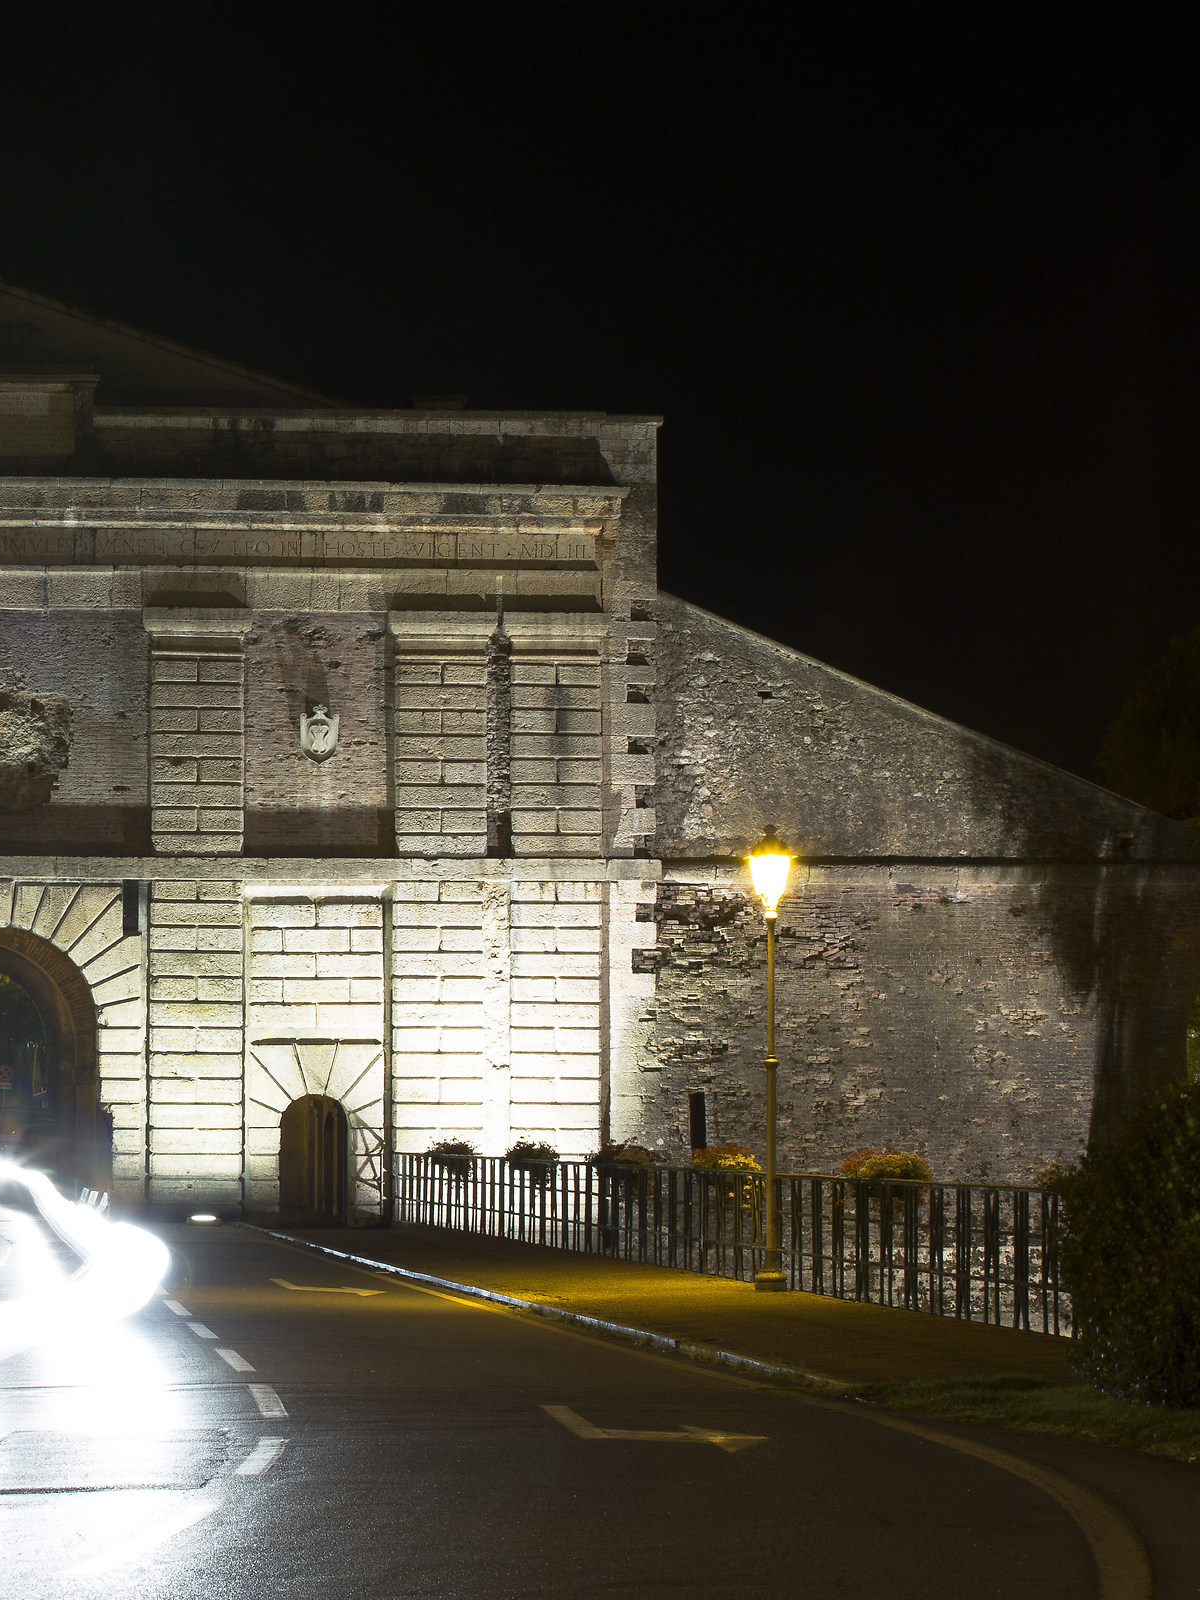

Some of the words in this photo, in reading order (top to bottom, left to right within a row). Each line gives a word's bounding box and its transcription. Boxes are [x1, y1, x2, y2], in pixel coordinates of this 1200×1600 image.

[96, 539, 166, 554] VENETI
[180, 540, 221, 555] CEV
[233, 541, 270, 556] LEO
[280, 542, 300, 557] IN
[412, 542, 499, 558] VIGENT
